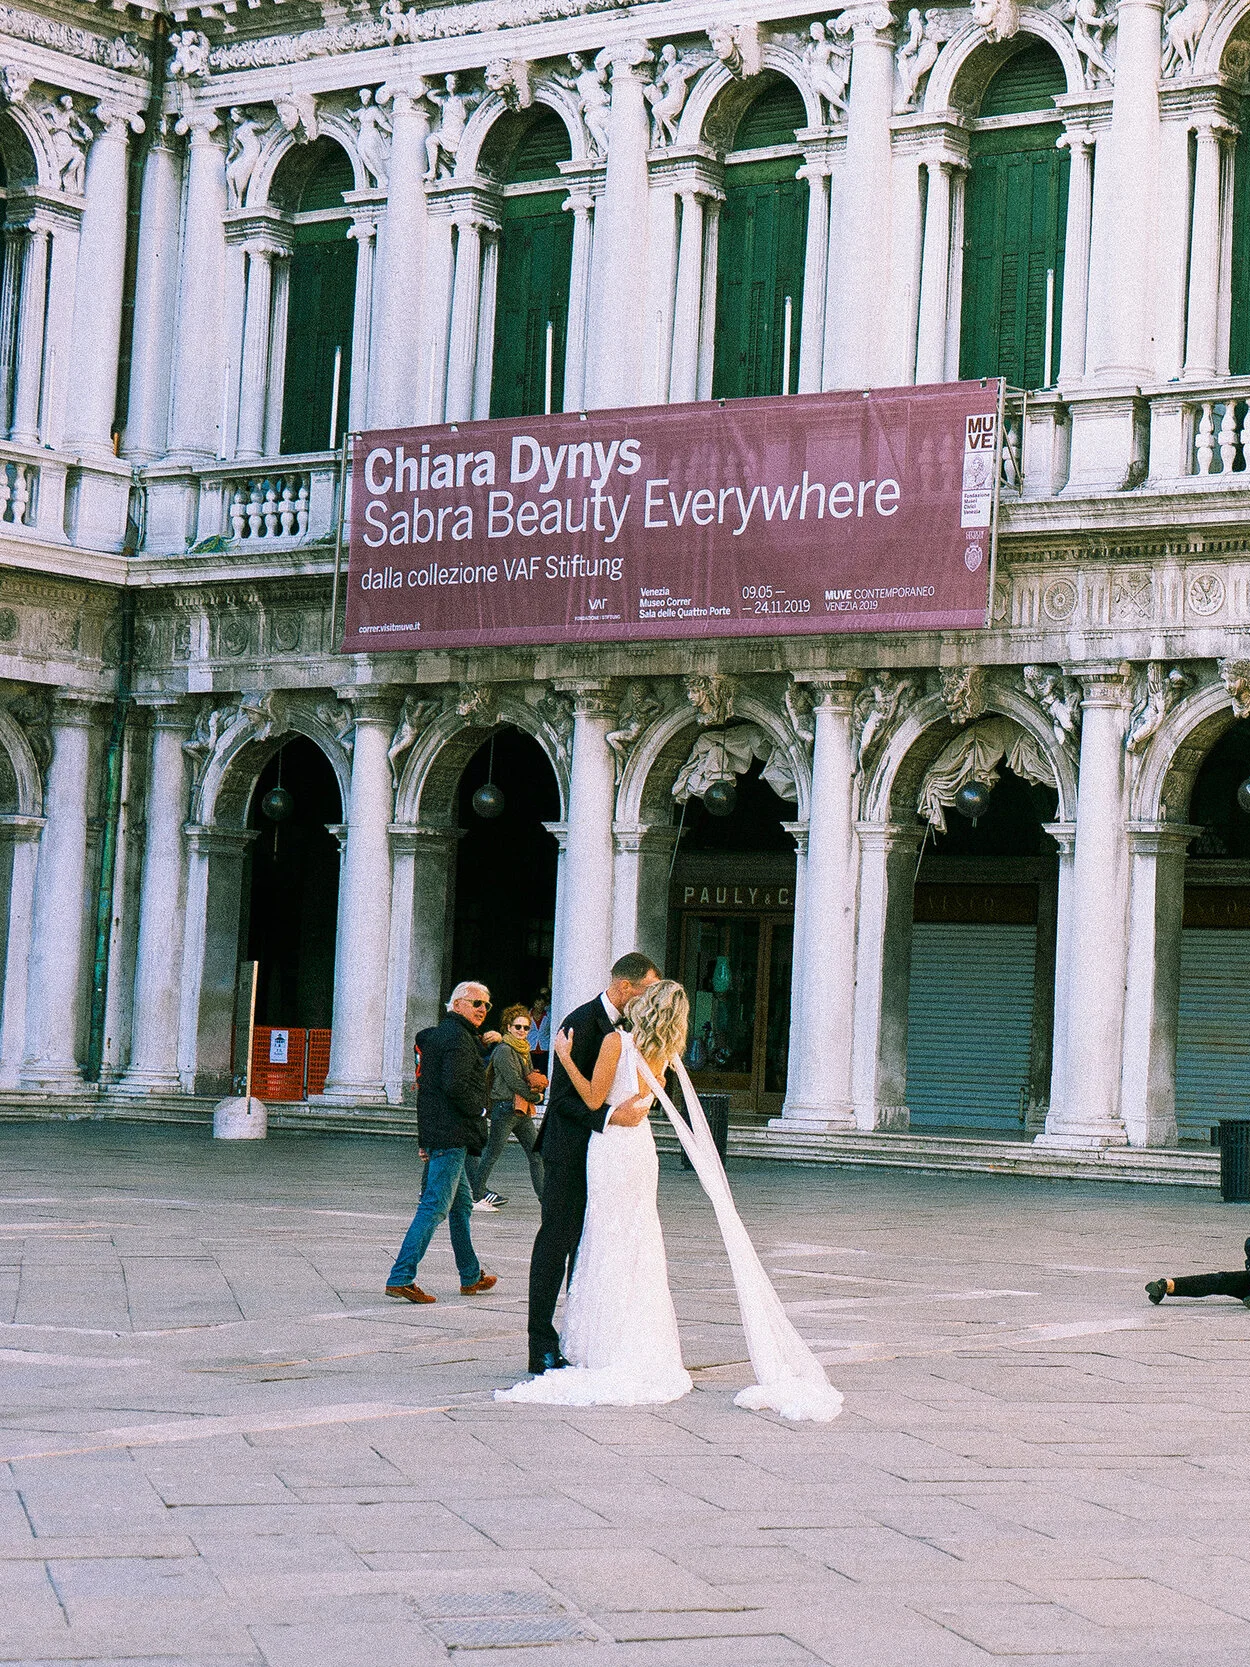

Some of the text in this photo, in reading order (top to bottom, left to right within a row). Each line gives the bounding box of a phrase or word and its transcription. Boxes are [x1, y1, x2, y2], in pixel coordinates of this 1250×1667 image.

[967, 416, 994, 434] MU
[967, 433, 993, 450] VE
[364, 435, 642, 495] Chiara Dynys
[363, 470, 901, 548] Sabra Beauty Everywhere
[361, 554, 624, 590] dalla collezione VAF Stiftung
[640, 587, 670, 597] Venezia
[742, 585, 773, 599] 09.05
[825, 585, 935, 601] MUVE CONTEMPORANEO
[639, 598, 692, 608] Museo Correr
[754, 600, 811, 614] 24.11.2019
[825, 600, 878, 611] VENEZIA 2019
[639, 606, 731, 619] Sala delle Quattro Porte
[358, 622, 421, 634] correr.visitmuve.it
[684, 886, 758, 904] PAULY
[765, 893, 771, 904] &
